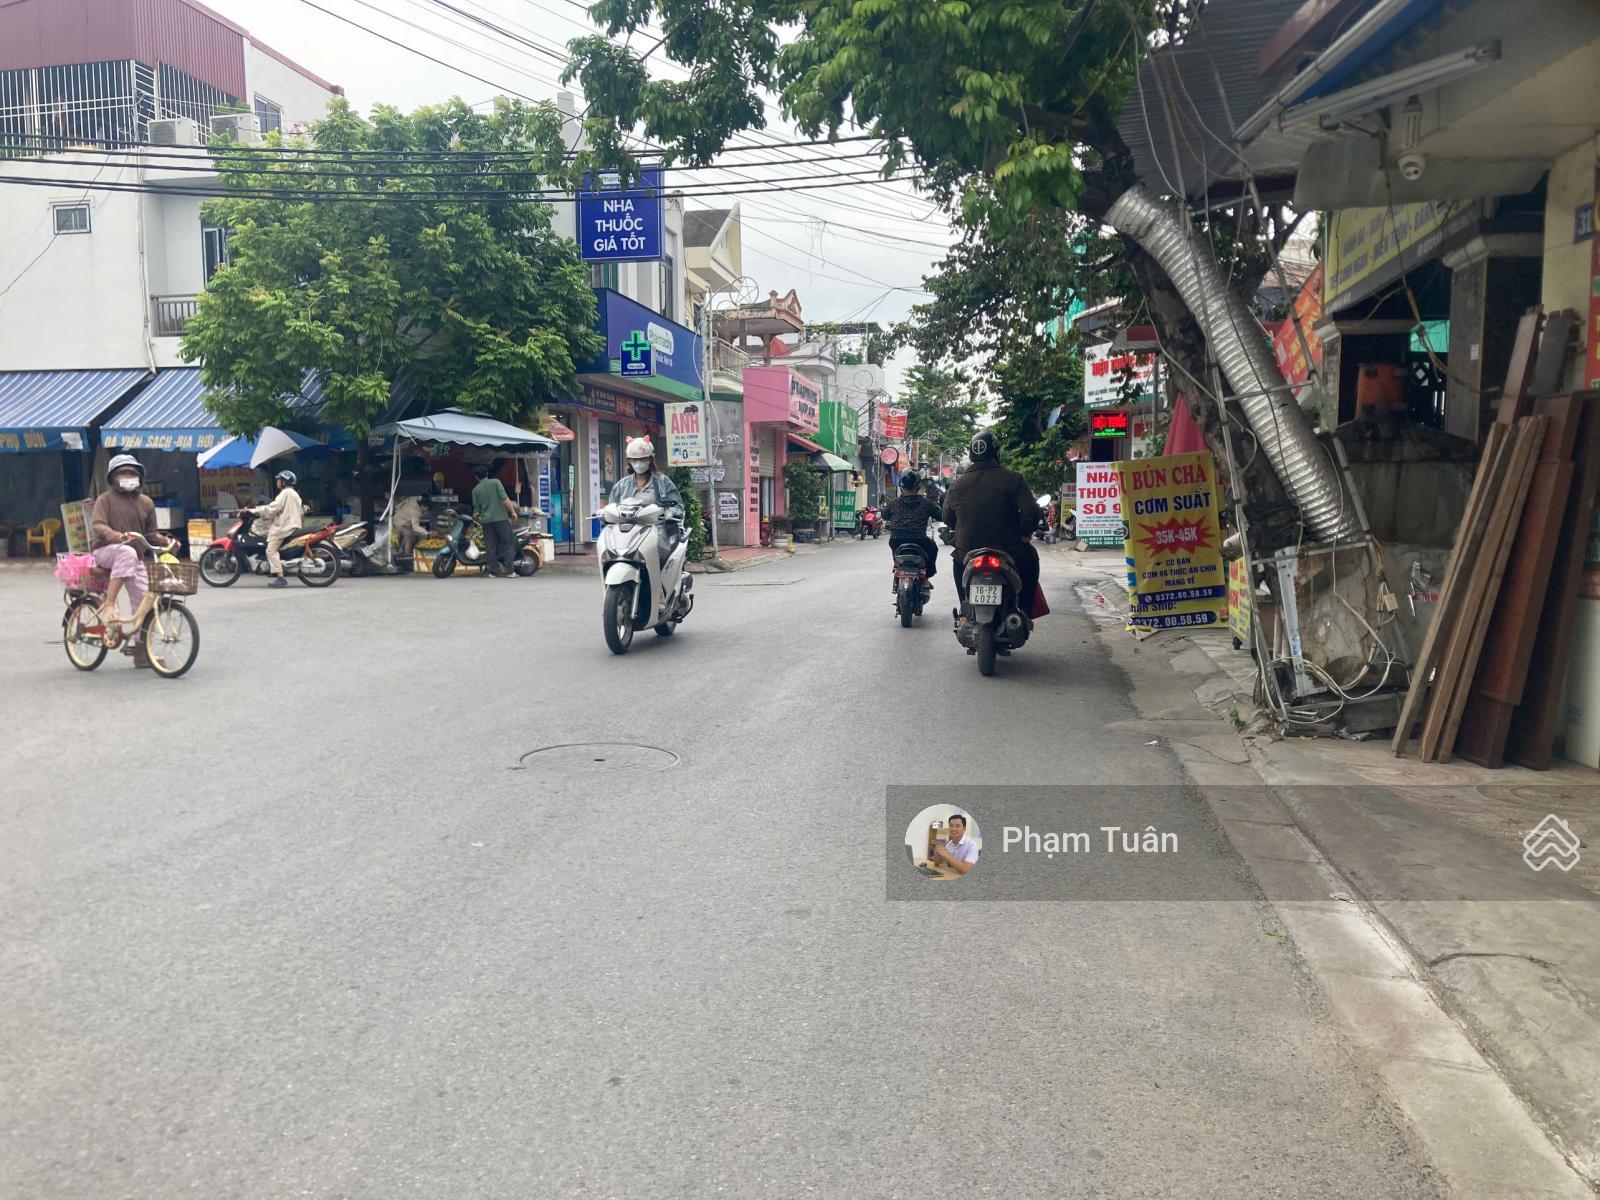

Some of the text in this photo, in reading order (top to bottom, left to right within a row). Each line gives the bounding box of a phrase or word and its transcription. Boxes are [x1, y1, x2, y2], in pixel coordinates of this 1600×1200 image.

[594, 212, 643, 232] THUỐC
[593, 231, 646, 252] GIÁ TỐT
[1131, 456, 1207, 490] BÚN CHẢ
[1083, 500, 1107, 515] SỐ
[1135, 488, 1210, 515] CƠM SUẤT
[1155, 526, 1198, 544] 35K-45K
[974, 595, 997, 604] 4022
